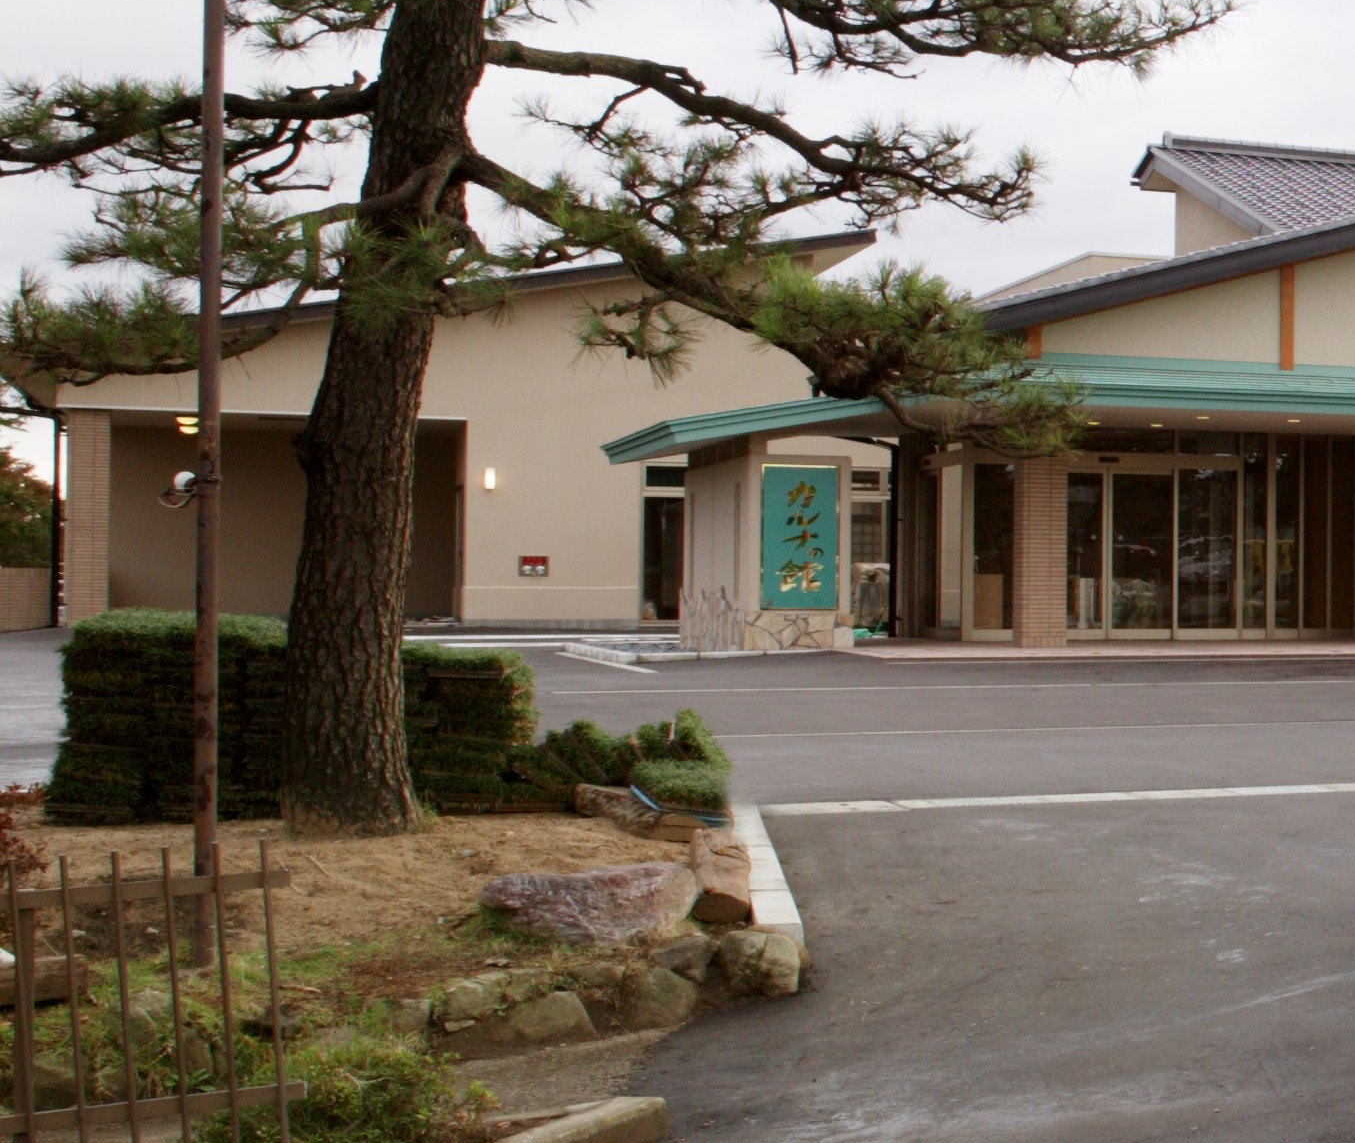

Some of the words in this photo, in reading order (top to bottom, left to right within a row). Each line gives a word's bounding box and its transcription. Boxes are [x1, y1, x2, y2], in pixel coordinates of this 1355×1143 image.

[776, 480, 825, 593] カルナの館
